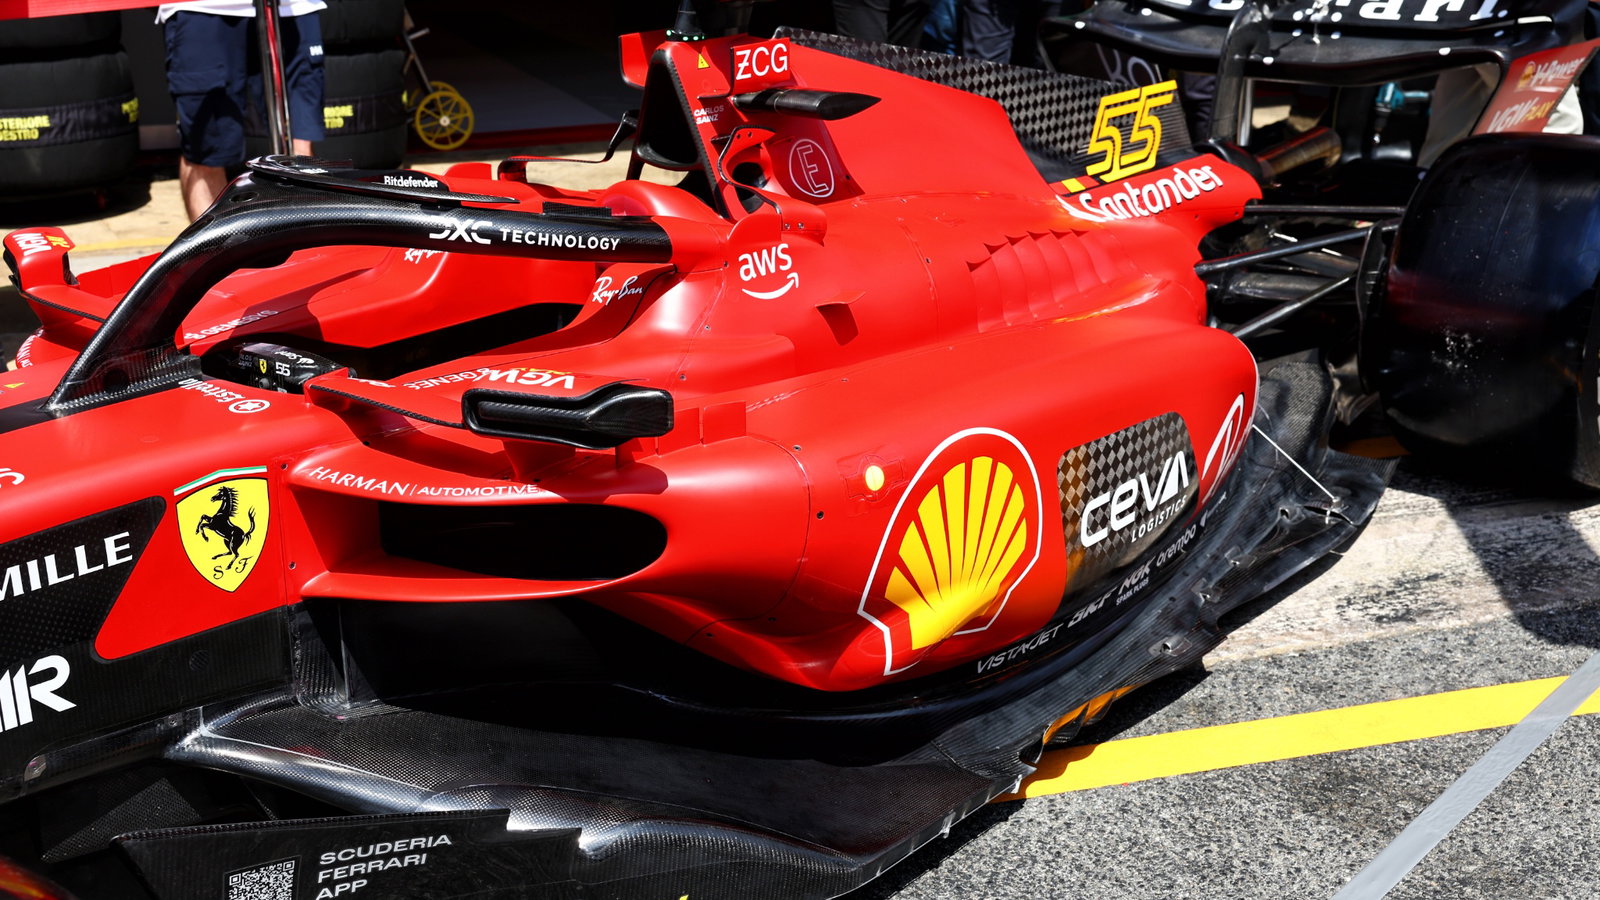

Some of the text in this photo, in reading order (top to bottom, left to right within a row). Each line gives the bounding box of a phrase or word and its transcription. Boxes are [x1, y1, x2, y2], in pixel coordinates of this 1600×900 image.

[693, 104, 725, 116] CARLOS
[695, 113, 719, 125] SAINZ
[1085, 80, 1178, 183] 55
[383, 175, 439, 188] Bitdefender
[1076, 164, 1224, 222] Santander
[499, 228, 621, 251] TECHNOLOGY
[738, 243, 793, 282] aws
[275, 361, 291, 377] 55
[308, 466, 539, 498] HARMAN AUTOMOTIVE
[1131, 494, 1188, 543] LOGISTICS
[319, 834, 452, 865] SCUDERIA
[317, 853, 427, 883] FERRARI
[315, 879, 368, 900] APP
